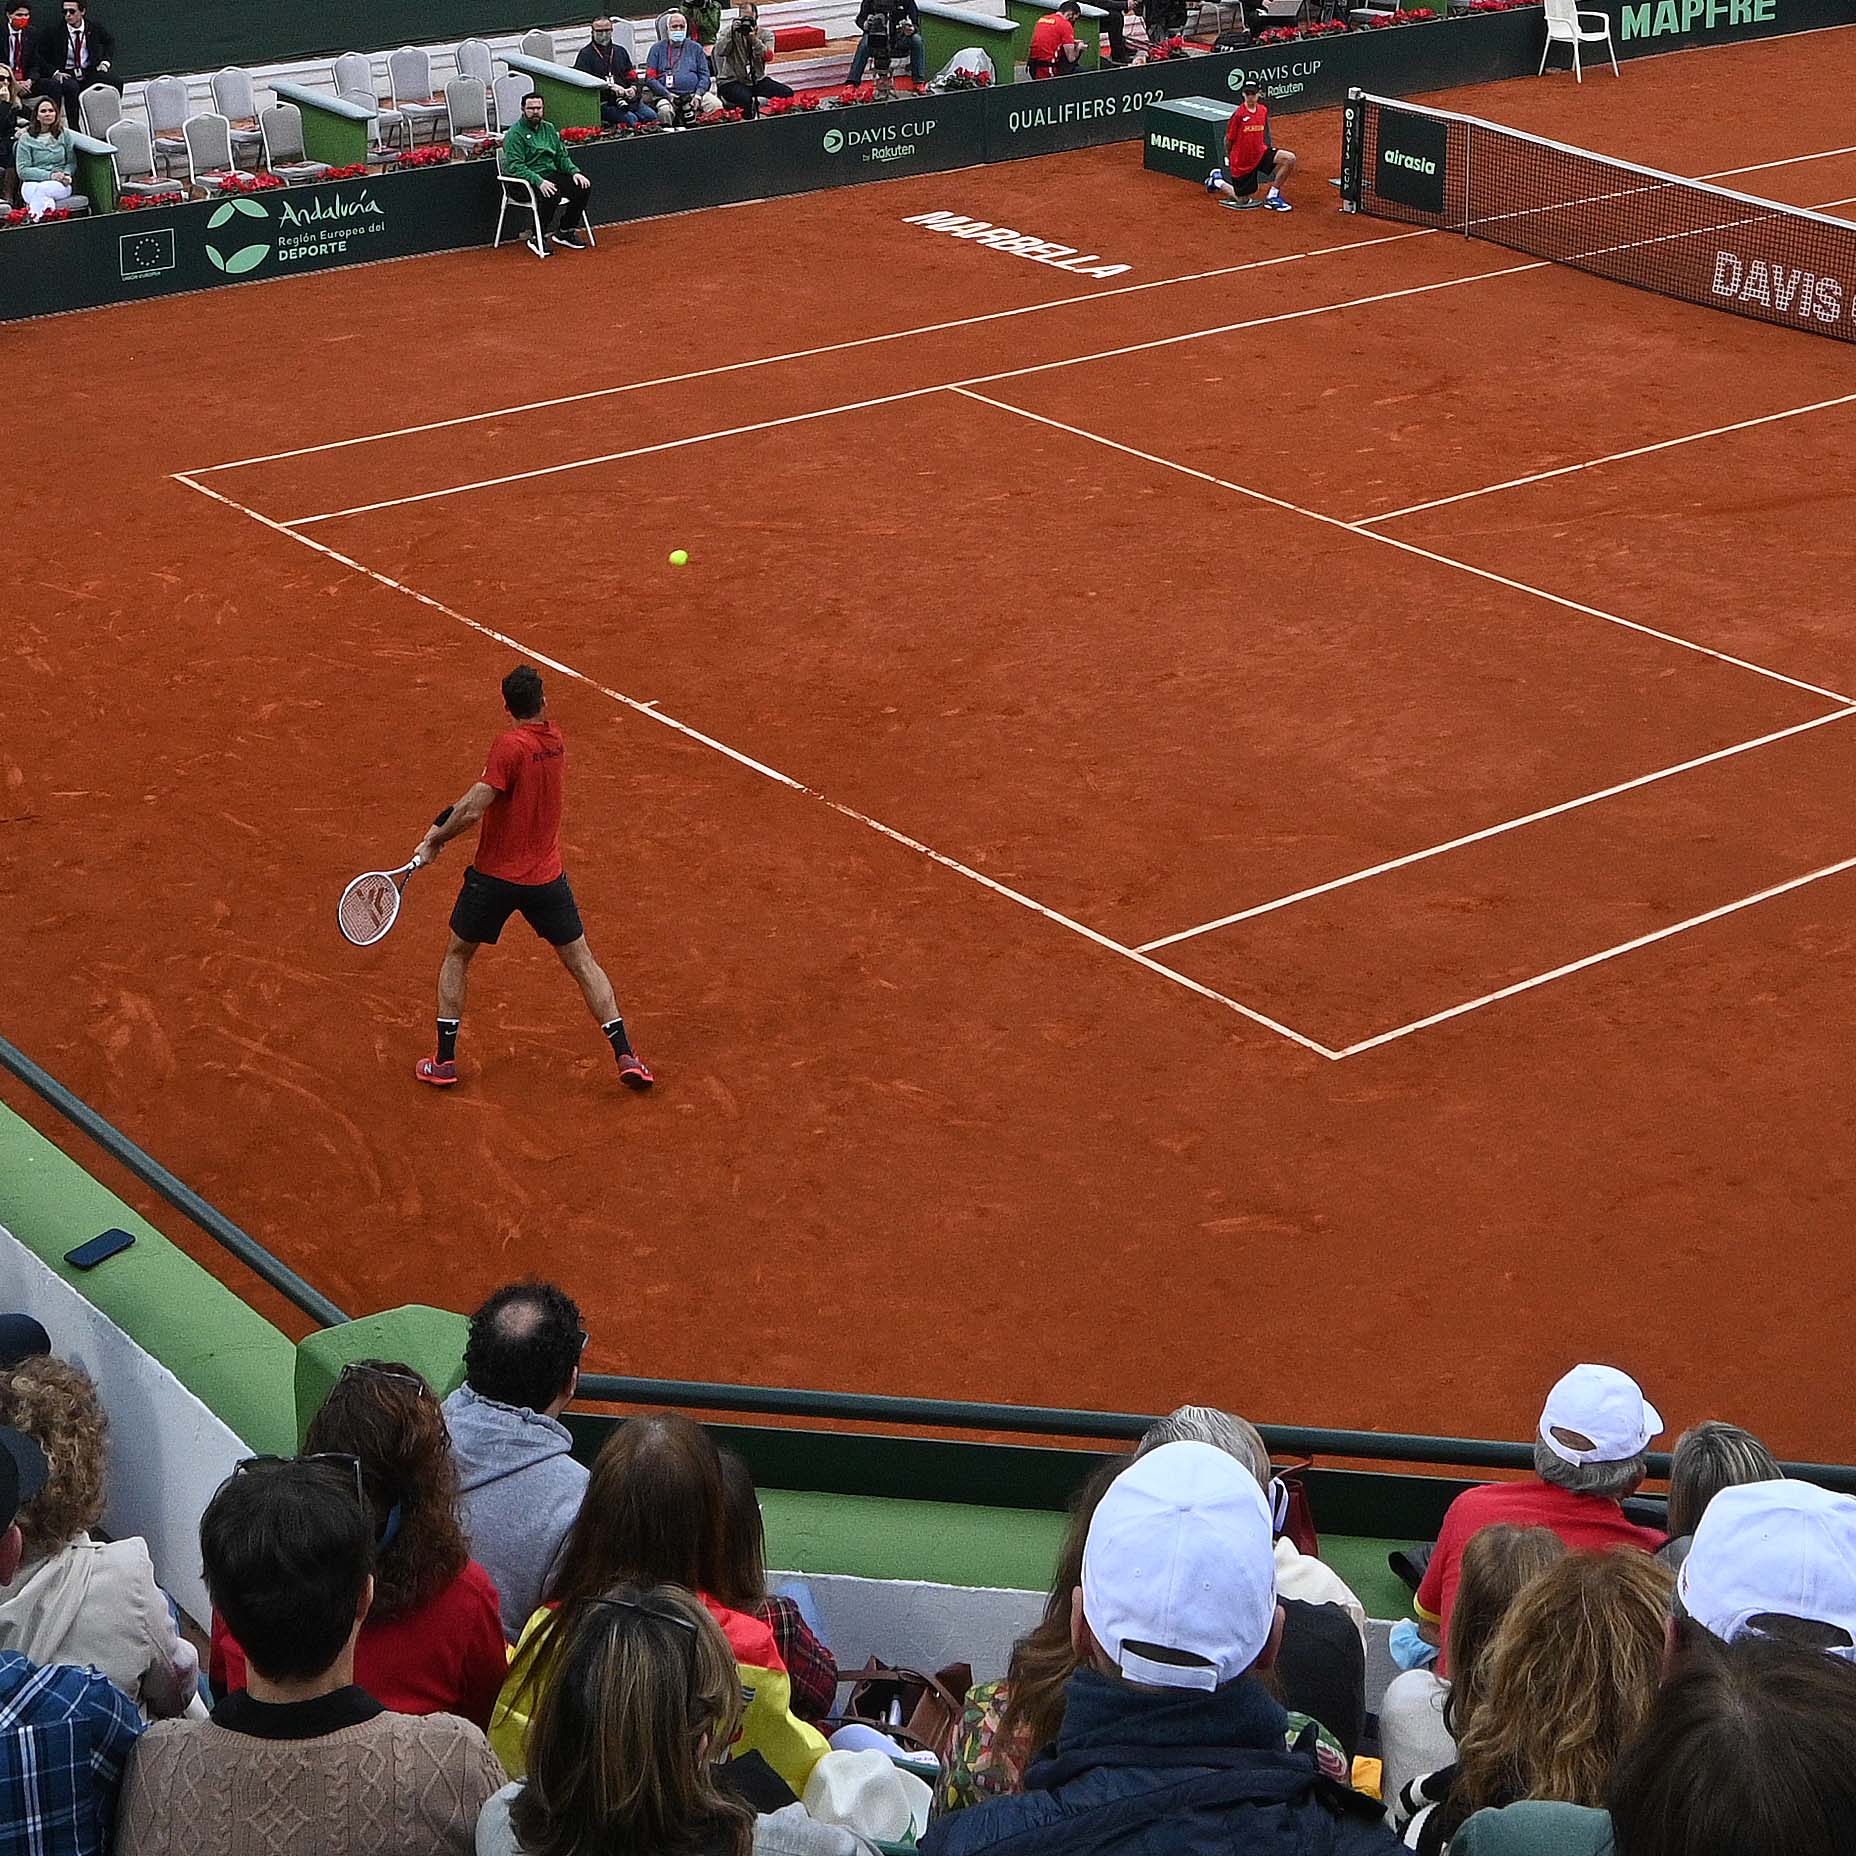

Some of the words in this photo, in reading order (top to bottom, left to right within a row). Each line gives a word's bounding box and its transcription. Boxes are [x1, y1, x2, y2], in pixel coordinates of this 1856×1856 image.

[1247, 65, 1289, 82] DAVIS
[1293, 61, 1322, 77] CUP
[1267, 82, 1304, 98] Rakuten
[1009, 97, 1116, 132] QUALIFIERS
[848, 125, 896, 145] DAVIS
[901, 120, 938, 137] CUP
[1345, 121, 1353, 160] DAVIS
[871, 143, 916, 160] Rakuten
[1151, 133, 1205, 159] MAPFRE
[1384, 149, 1436, 176] airasia
[279, 189, 384, 228] Andalucía
[278, 232, 317, 247] Región
[320, 225, 366, 241] Europea
[368, 221, 385, 233] del
[902, 209, 1133, 279] MARBELLA
[279, 241, 347, 261] DEPORTE
[1712, 250, 1842, 324] DAVIS
